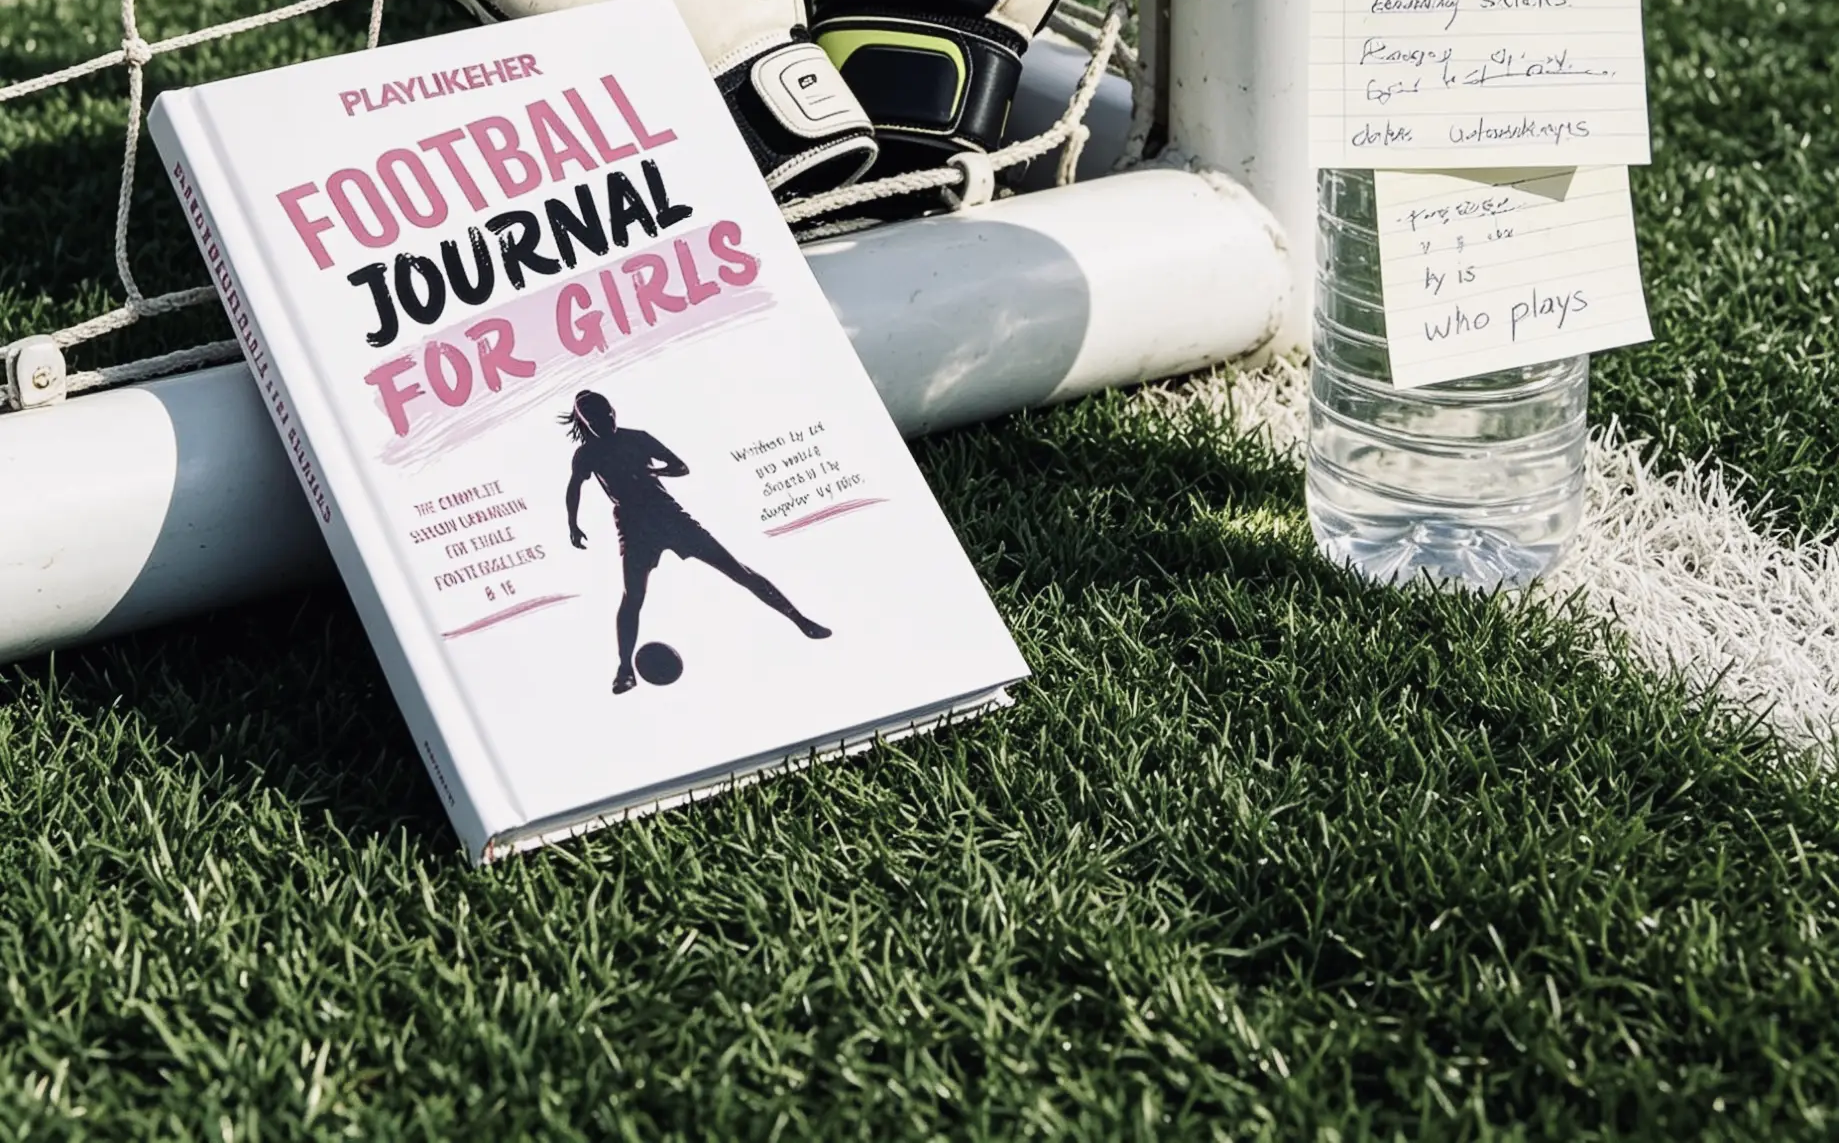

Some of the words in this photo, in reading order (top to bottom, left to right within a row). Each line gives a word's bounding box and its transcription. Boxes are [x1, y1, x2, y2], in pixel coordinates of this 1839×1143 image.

[338, 52, 544, 118] PLAYLIKEHER
[276, 74, 678, 271] FOOTBALL
[347, 158, 693, 348] JOURNAL
[1424, 305, 1490, 341] who
[1511, 287, 1588, 342] plays
[1458, 262, 1476, 284] is
[364, 317, 536, 437] FOR
[556, 219, 762, 353] GIRLS
